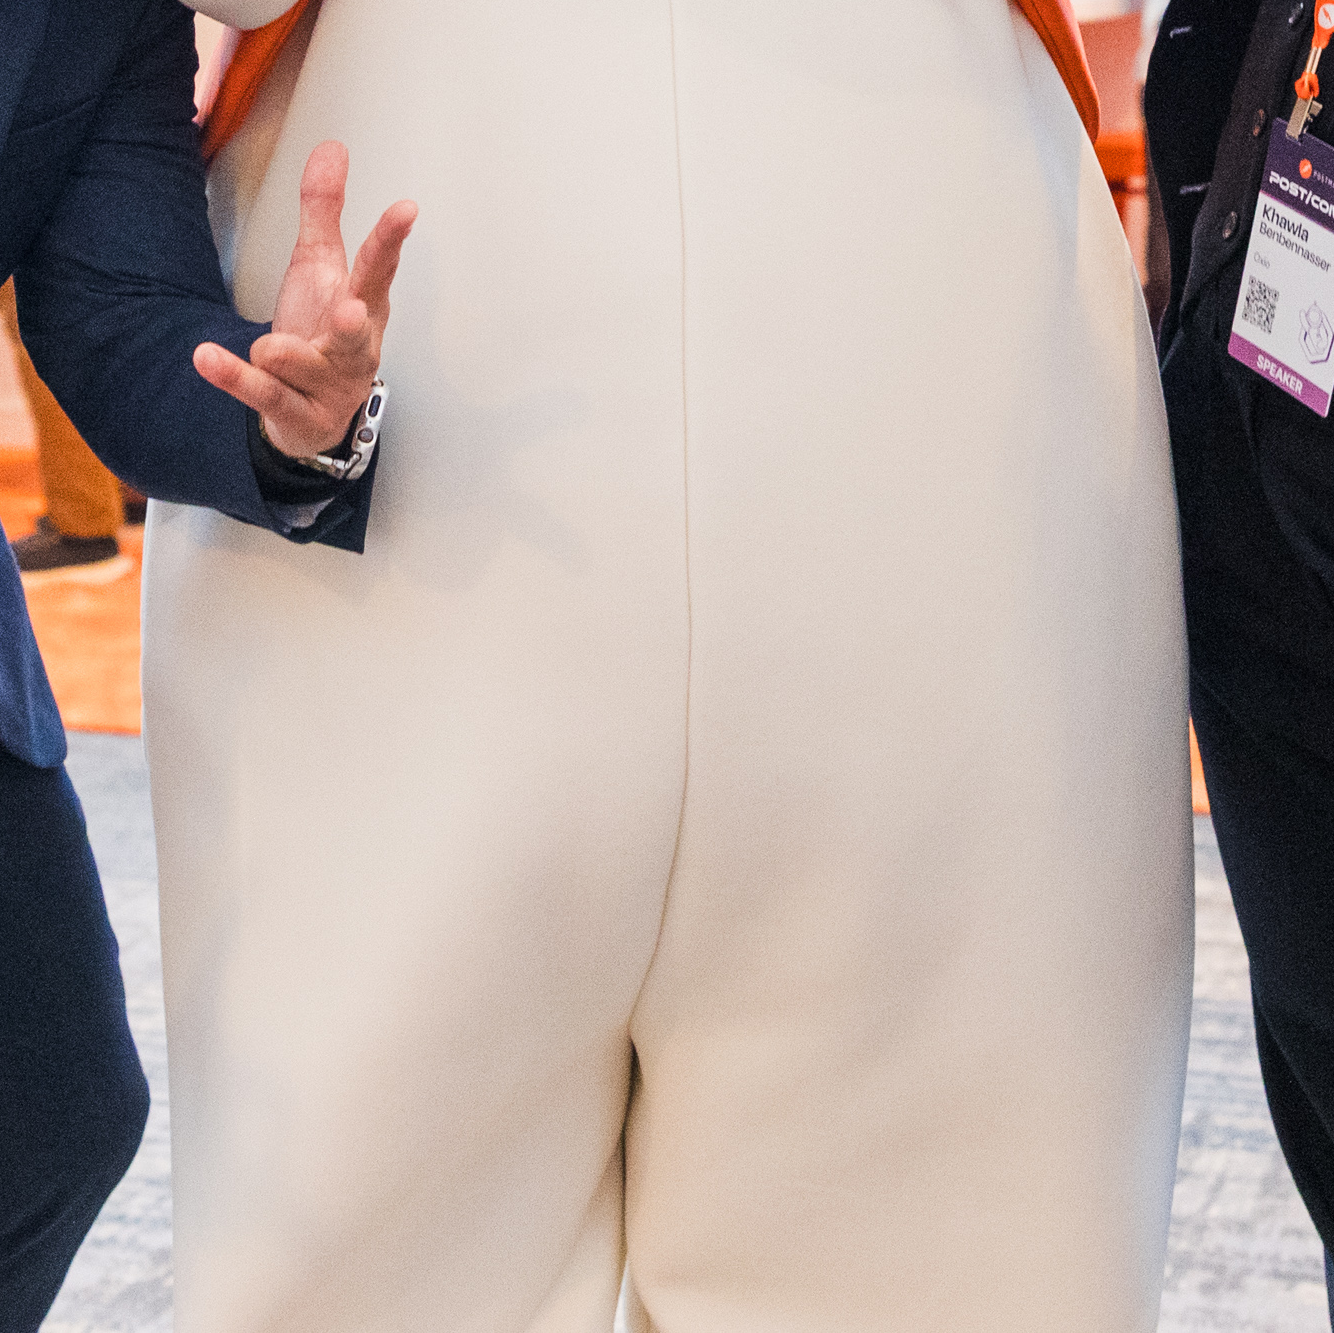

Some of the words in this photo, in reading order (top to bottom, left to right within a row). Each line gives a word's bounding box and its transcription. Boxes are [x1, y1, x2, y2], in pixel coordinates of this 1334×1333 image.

[1262, 204, 1309, 243] Khawla
[1259, 221, 1332, 272] Benbennasser
[1256, 354, 1303, 395] SPEAKER
